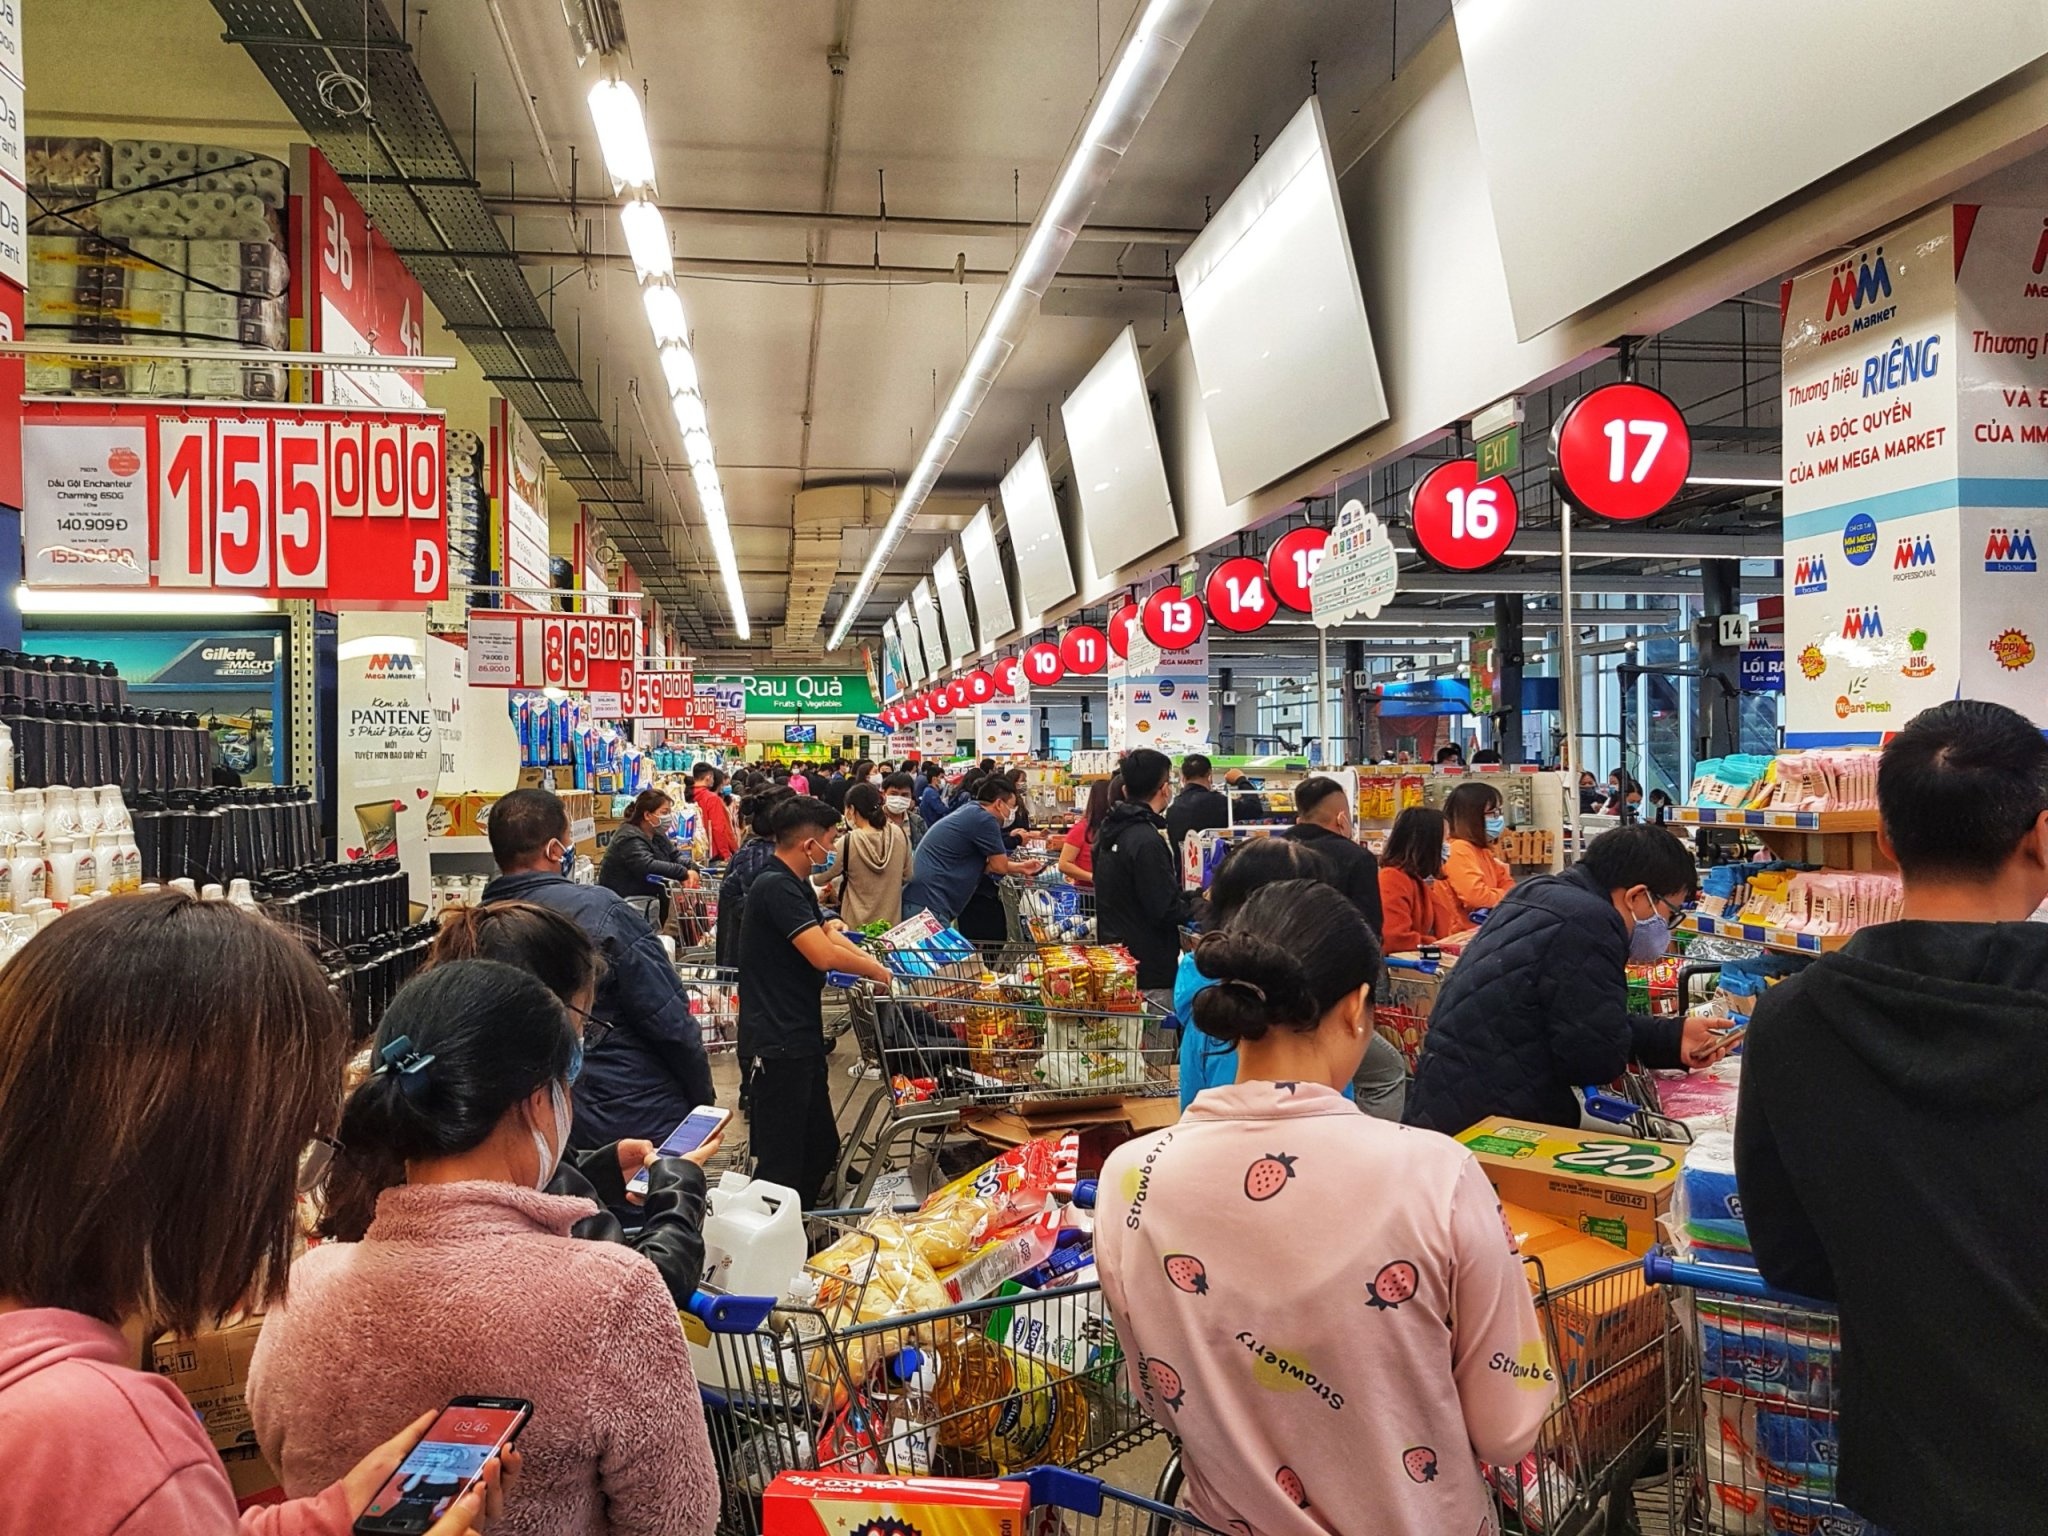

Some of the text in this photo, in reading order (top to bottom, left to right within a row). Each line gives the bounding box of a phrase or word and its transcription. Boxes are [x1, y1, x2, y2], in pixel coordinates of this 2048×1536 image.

[323, 195, 353, 291] 3b
[1973, 331, 2038, 359] Thương
[1789, 335, 1940, 407] Thương hiệu RIÊNG
[2003, 386, 2031, 407] VÀ
[1806, 397, 1912, 447] VÀ ĐỘC QUYỀN
[1974, 419, 2014, 443] CỦA
[1484, 435, 1509, 472] EXIT
[1603, 418, 1669, 483] 17
[1789, 427, 1946, 484] CỦA MM MEGA MARKET
[83, 479, 133, 488] Enchanteur
[57, 491, 124, 501] Charming 650G
[1446, 486, 1499, 539] 16
[1857, 533, 1876, 543] MEGA
[1846, 543, 1874, 556] MARKET
[412, 539, 441, 594] Đ
[1893, 569, 1936, 582] PROFESSIONAL
[1225, 576, 1265, 613] 14
[1160, 601, 1192, 633] 13
[1723, 620, 1743, 639] 14
[202, 647, 256, 660] Gillette
[1076, 638, 1095, 663] 11
[1988, 640, 2021, 653] Happy
[229, 660, 275, 673] MACH3
[1033, 652, 1057, 674] 10
[1743, 656, 1764, 673] LỐI
[1910, 656, 1928, 667] BIG
[741, 676, 843, 699] Rau Quả
[974, 678, 986, 695] 8
[1356, 673, 1366, 686] 10
[1766, 675, 1780, 683] only
[372, 697, 410, 708] Kem xả
[937, 694, 947, 708] 6
[956, 687, 964, 702] 7
[805, 700, 842, 709] Vegetables
[351, 710, 431, 725] PANTENE
[348, 728, 355, 737] 3
[358, 725, 387, 737] Phút
[388, 726, 415, 738] Diệu
[384, 740, 398, 749] MỚI
[354, 748, 428, 760] TUYỆT HƠN BAO GIỜ HẾT
[1126, 1132, 1174, 1231] Strawberry
[1609, 1192, 1642, 1206] 600142
[1235, 1331, 1345, 1410] Strawberry
